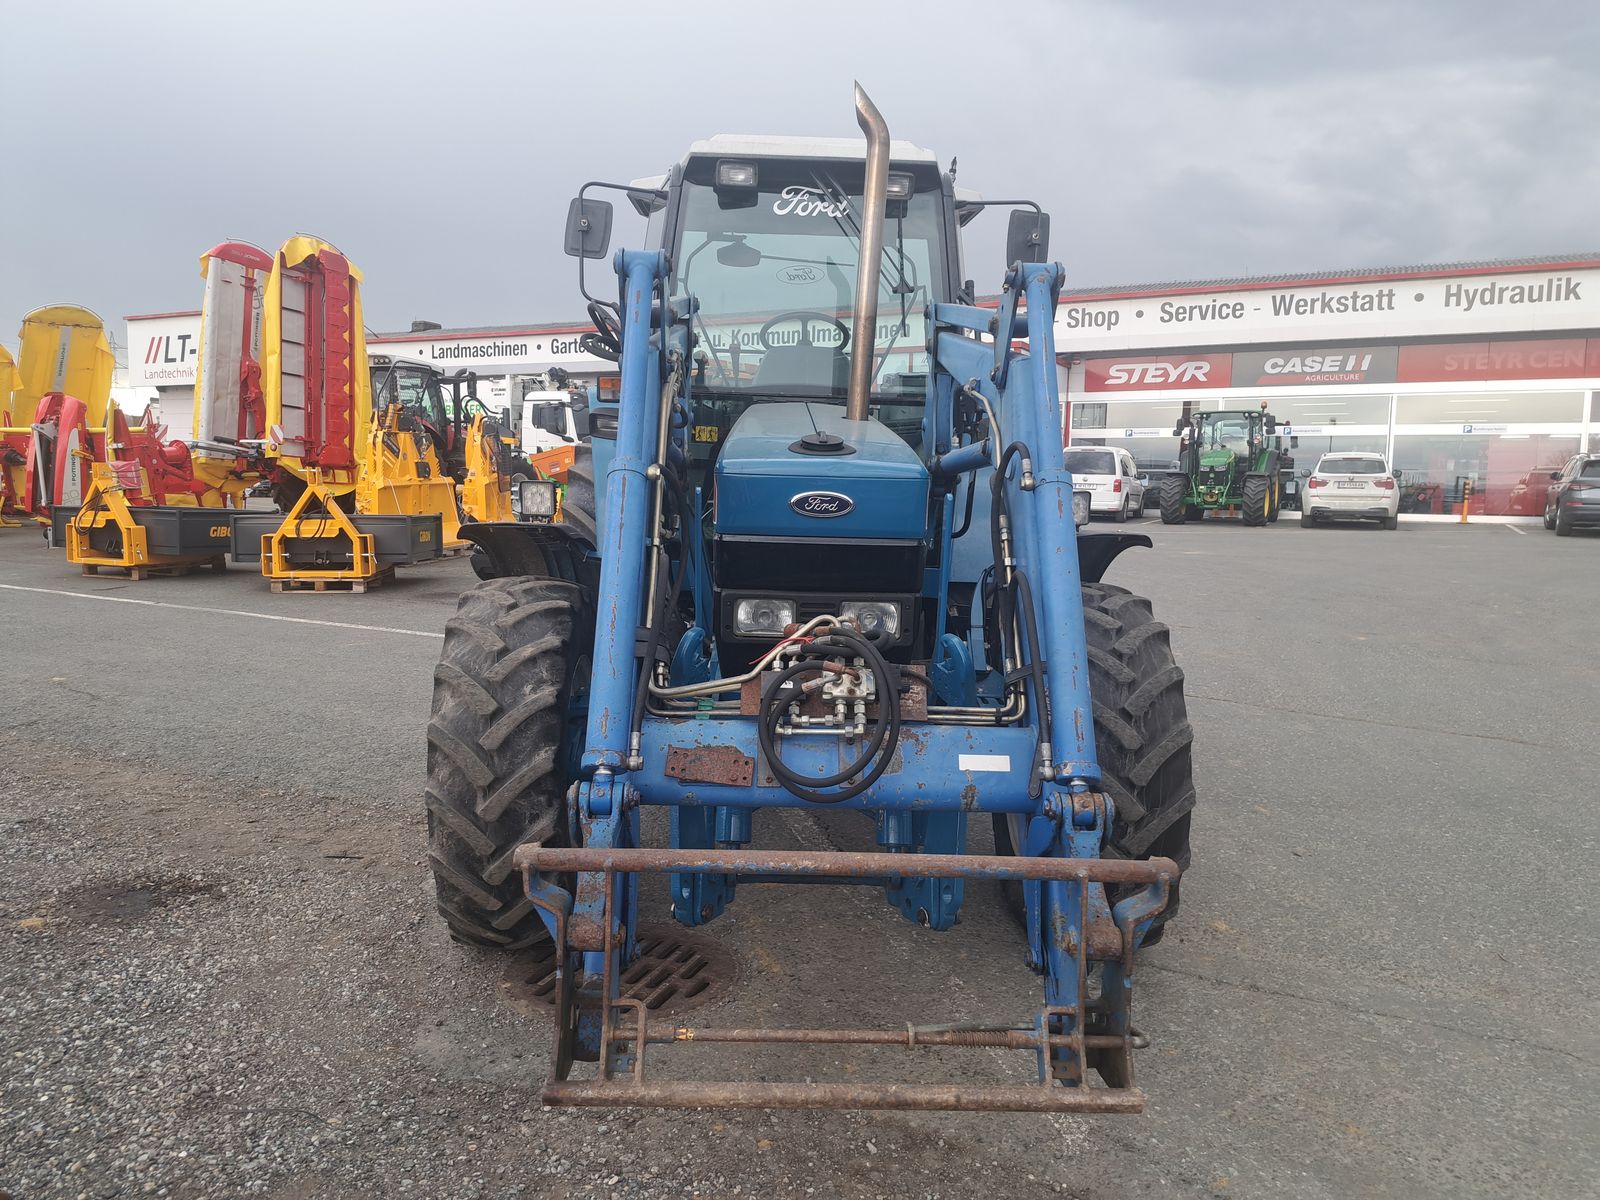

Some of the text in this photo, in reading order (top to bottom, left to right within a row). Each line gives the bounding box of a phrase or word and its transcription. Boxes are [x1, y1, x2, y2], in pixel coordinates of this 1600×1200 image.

[773, 185, 850, 218] Ford
[1444, 276, 1582, 312] Hydraulik
[1159, 298, 1245, 324] Service
[1271, 288, 1396, 317] Werkstatt
[1066, 307, 1120, 331] Shop
[431, 341, 528, 360] Landmaschinen
[1264, 355, 1344, 374] CASE
[1444, 351, 1523, 371] STEYR
[144, 367, 195, 380] Landtechnik
[1104, 361, 1211, 385] STEYR
[1305, 373, 1360, 382] AGRICULTURE
[804, 496, 839, 511] Ford
